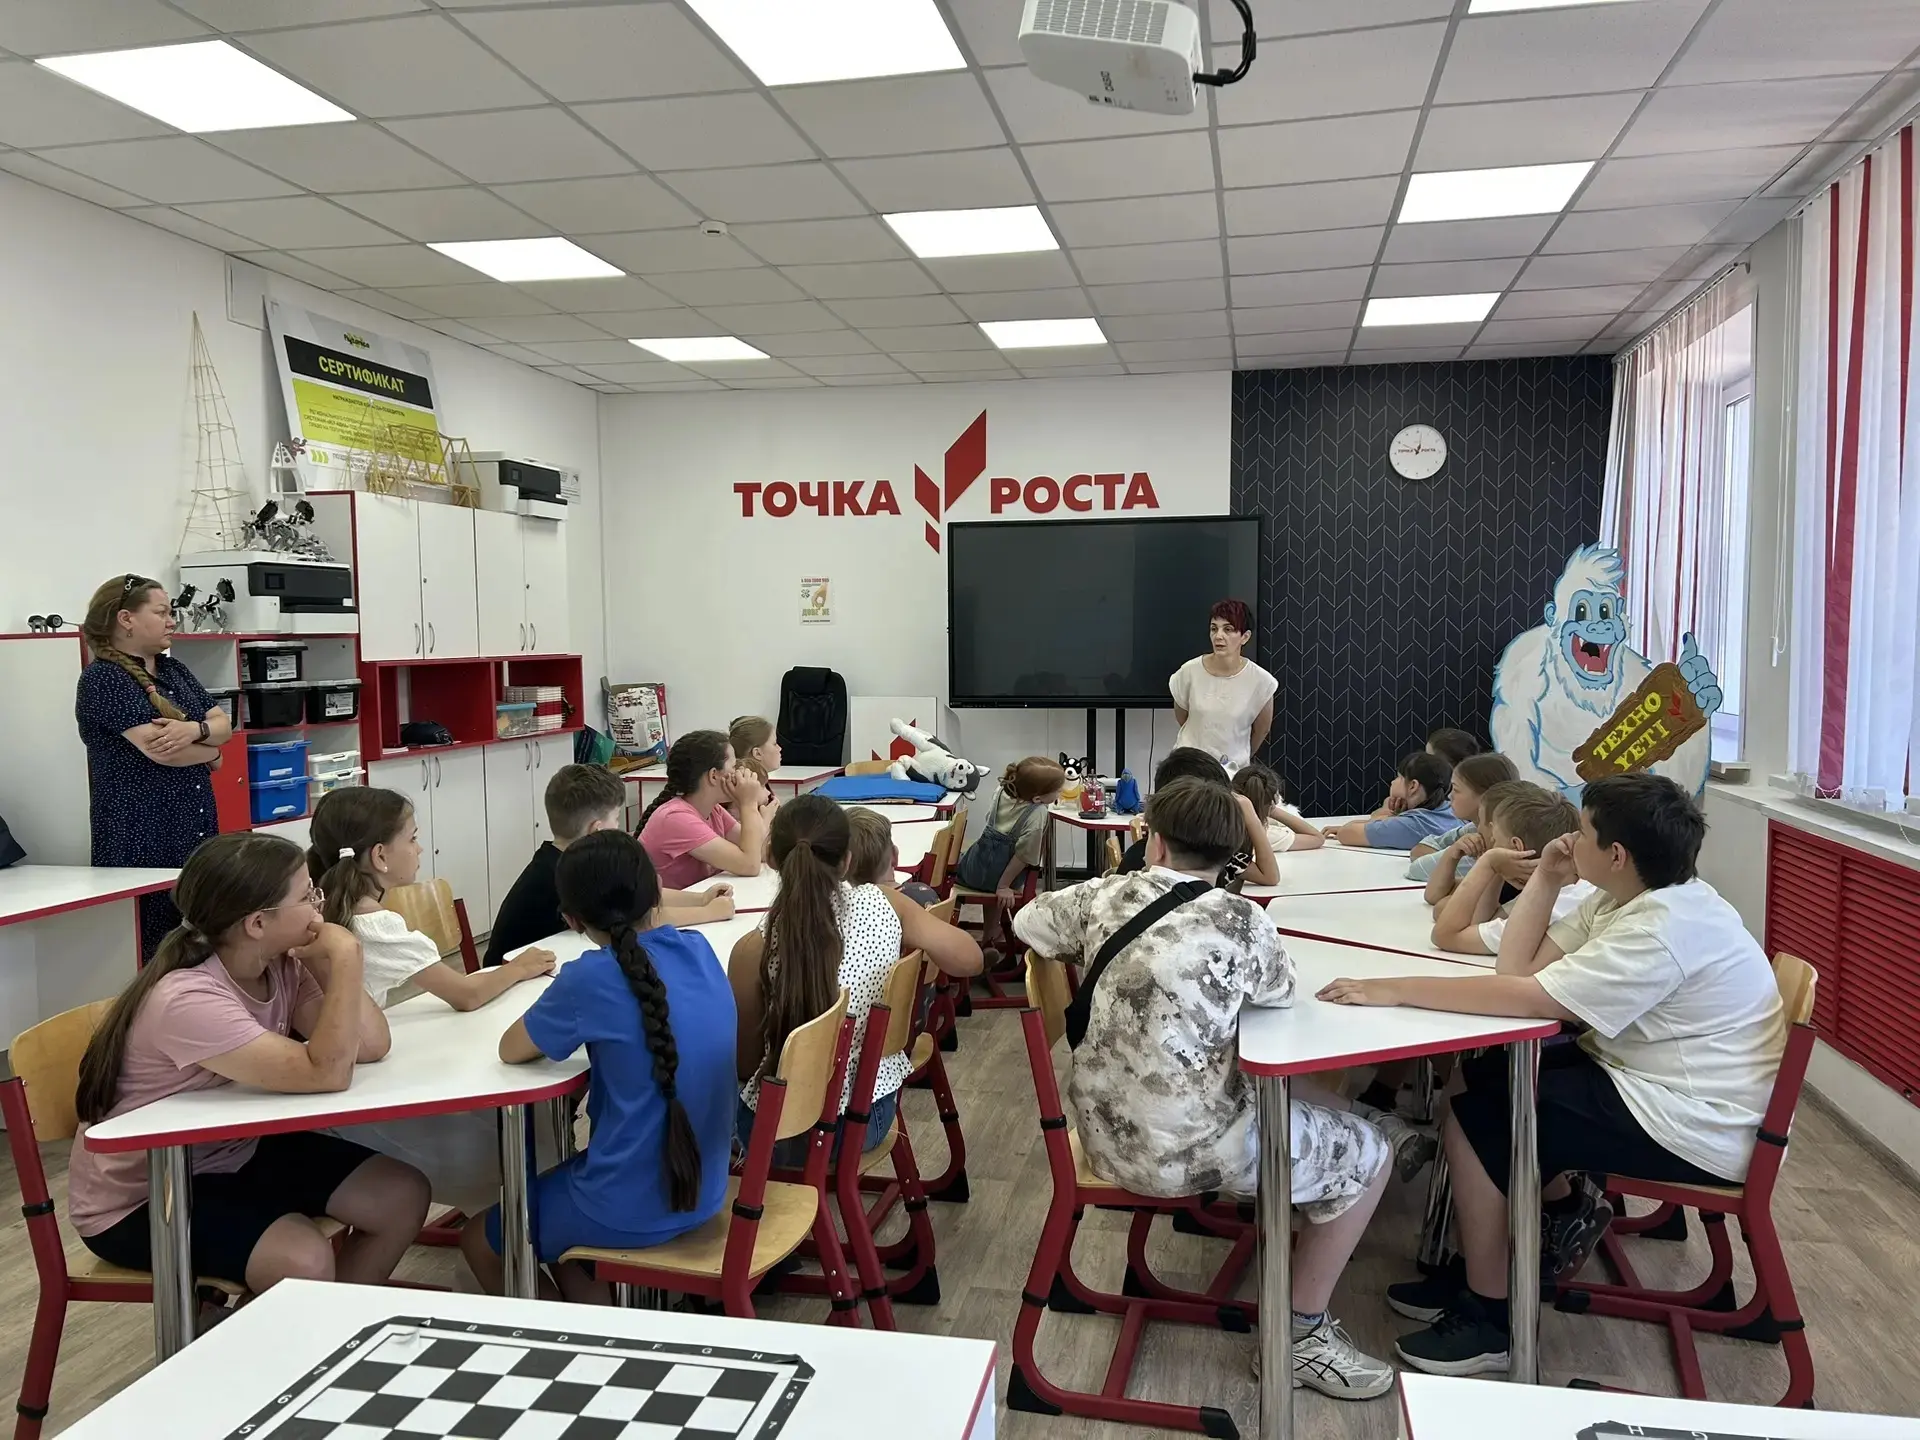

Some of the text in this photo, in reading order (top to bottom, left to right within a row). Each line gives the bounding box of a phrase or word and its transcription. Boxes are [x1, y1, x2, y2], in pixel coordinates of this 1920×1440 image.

[318, 355, 405, 394] СЕРТИФИКАТ
[733, 471, 1161, 518] ТОЧКА РОСТА
[1593, 691, 1662, 761] ТЕХНО
[1613, 719, 1671, 772] YETI
[345, 1339, 361, 1349] 8
[465, 1324, 478, 1332] B
[512, 1329, 523, 1337] C
[557, 1334, 569, 1342] D
[604, 1339, 616, 1347] E
[701, 1347, 713, 1355] G
[751, 1352, 764, 1360] H
[312, 1365, 329, 1376] 7
[276, 1393, 293, 1404] 6
[785, 1391, 796, 1400] 8
[238, 1423, 257, 1435] 5
[768, 1420, 779, 1430] 7
